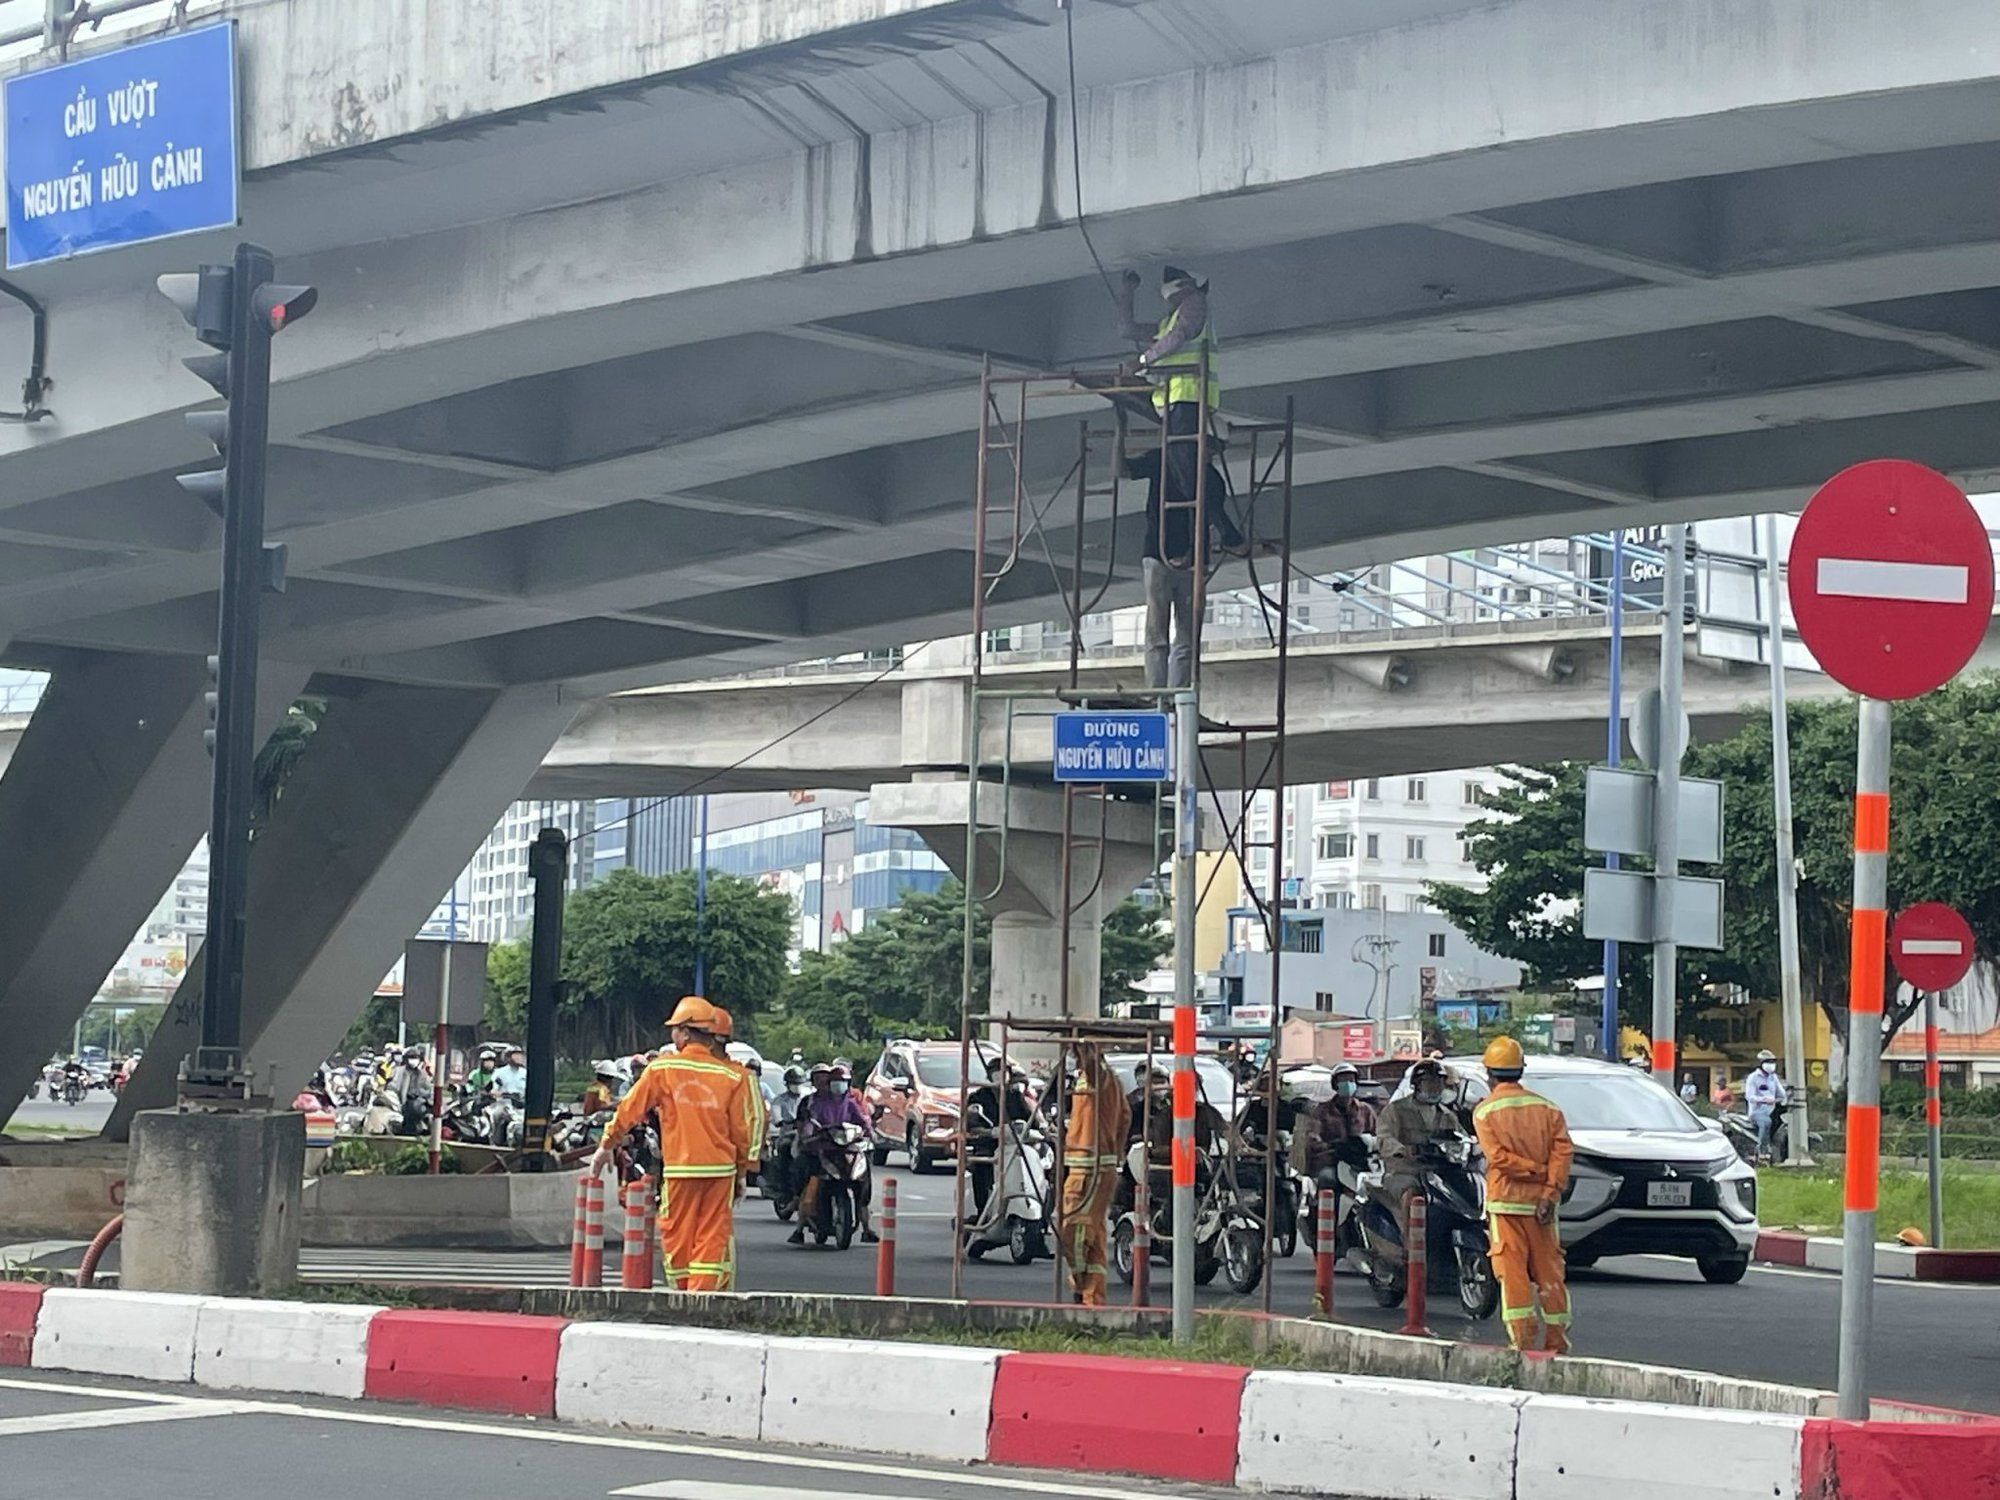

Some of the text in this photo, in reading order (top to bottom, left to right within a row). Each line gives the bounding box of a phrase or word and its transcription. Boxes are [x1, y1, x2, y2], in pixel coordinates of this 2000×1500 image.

[65, 78, 158, 138] CẦU VƯỢT
[23, 141, 203, 221] NGUYỄN HỮU CẢNH
[1084, 718, 1140, 737] ĐƯỜNG
[1058, 740, 1165, 770] NGUYỄN HỮU CẢNH
